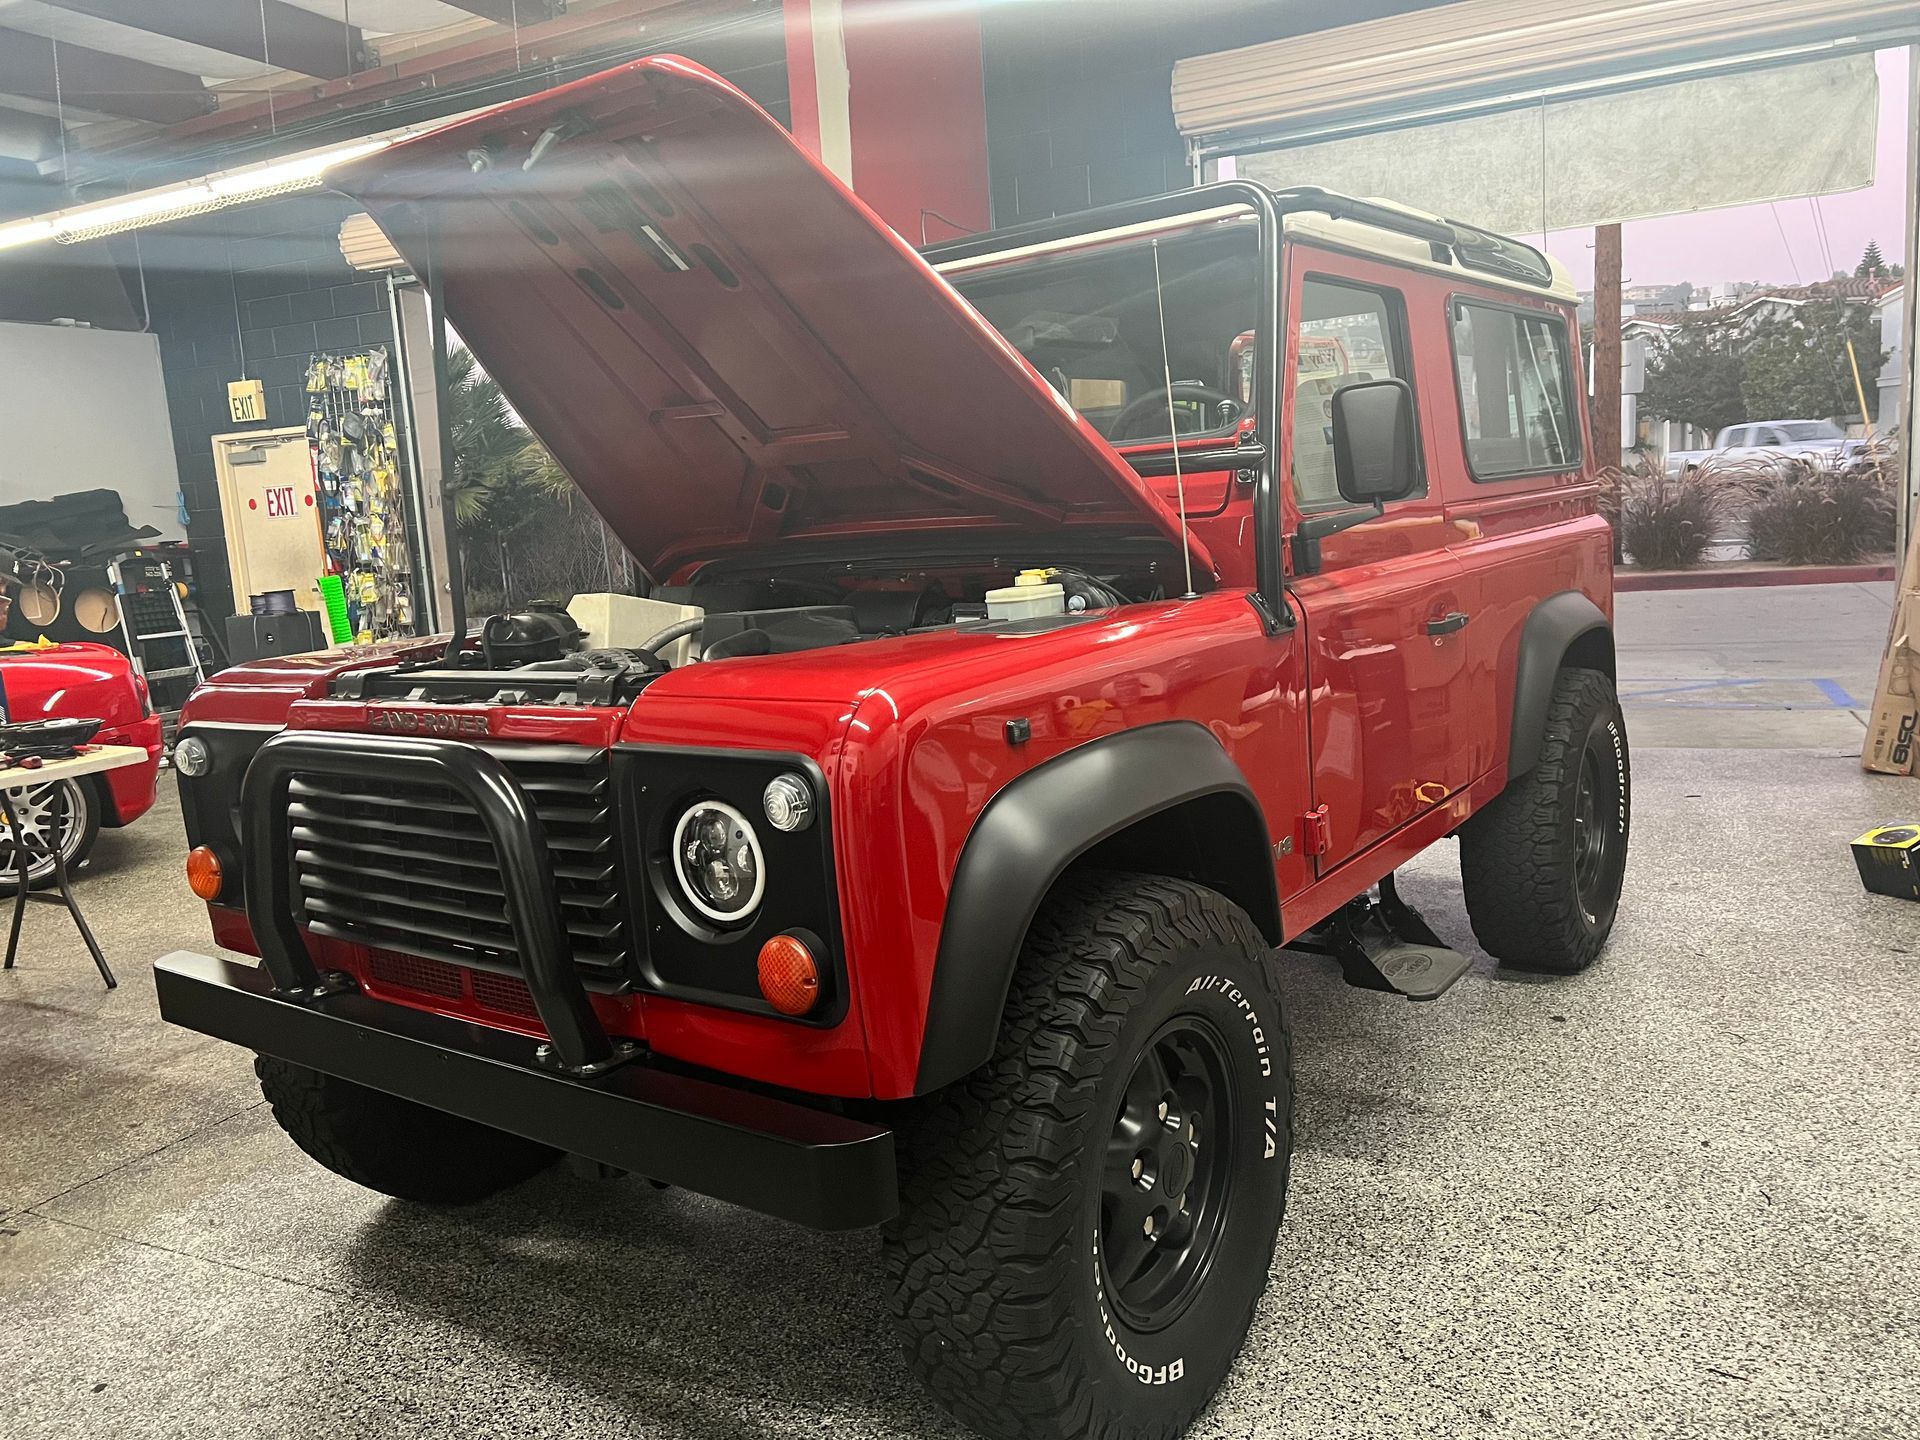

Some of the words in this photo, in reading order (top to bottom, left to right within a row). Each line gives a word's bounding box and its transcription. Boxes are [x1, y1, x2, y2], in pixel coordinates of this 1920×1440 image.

[232, 396, 255, 420] EXIT
[266, 487, 294, 517] EXIT
[368, 710, 418, 730] LAND
[423, 712, 489, 735] ROVER
[1606, 720, 1625, 834] BFGoodrich
[1264, 1096, 1277, 1159] T/A
